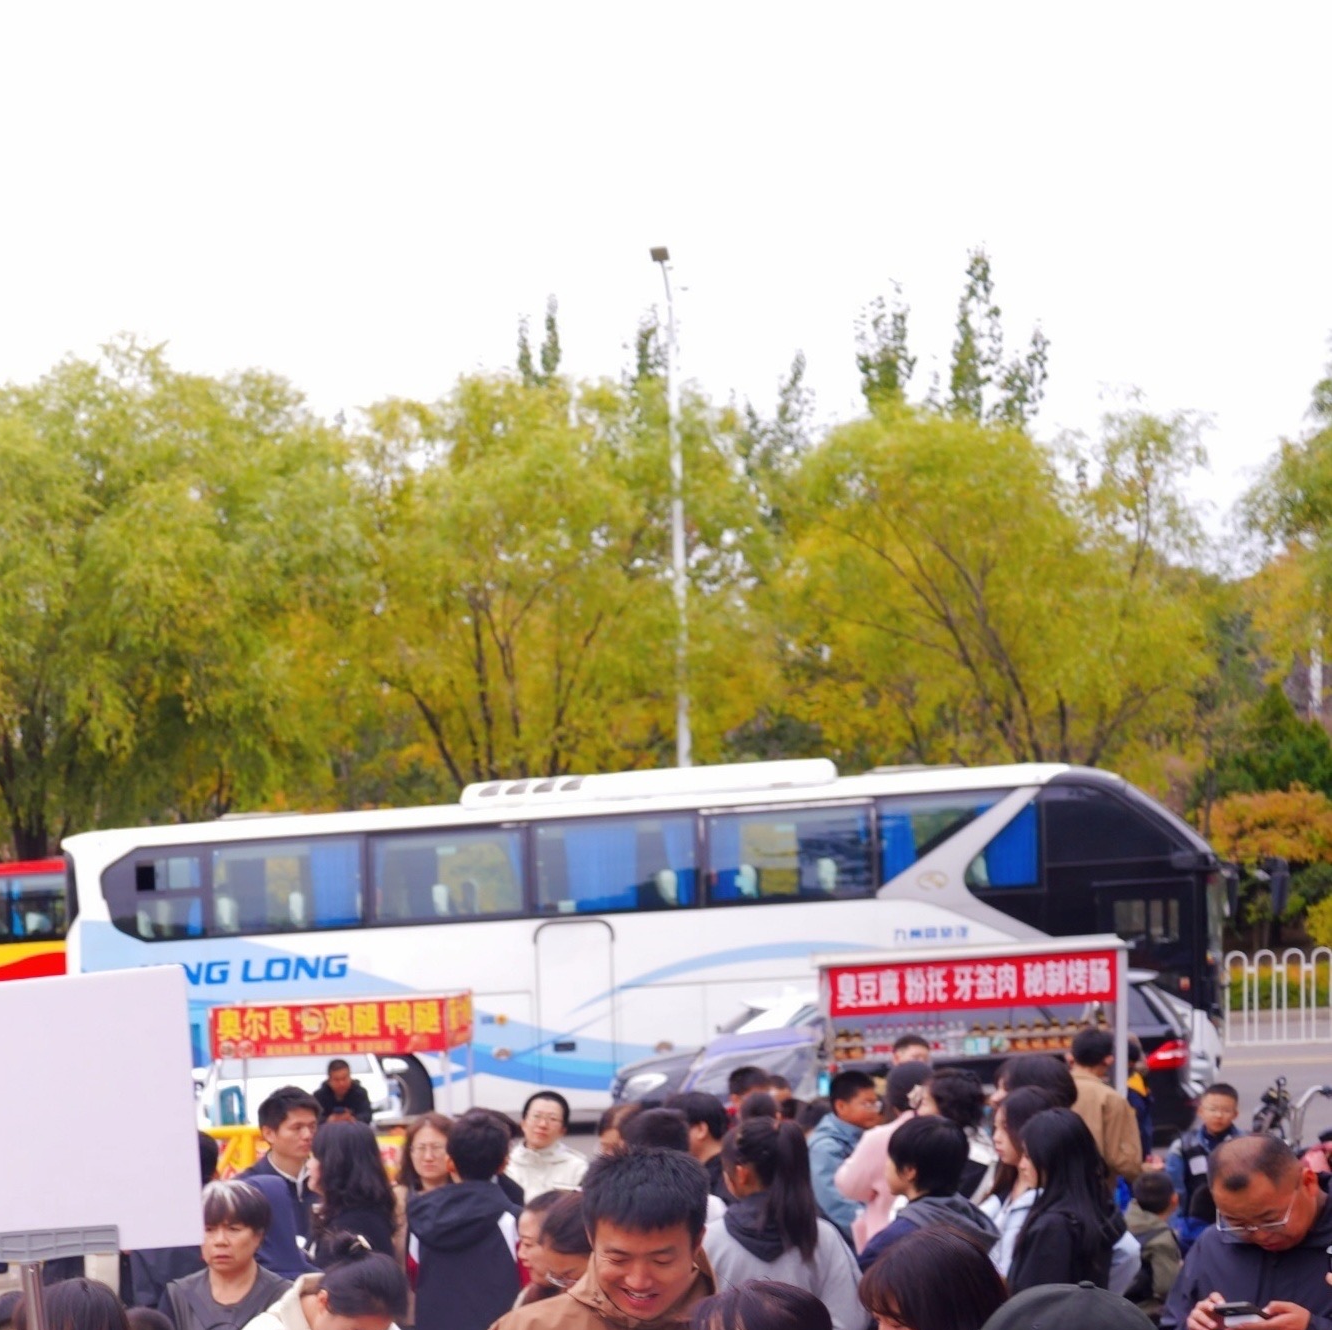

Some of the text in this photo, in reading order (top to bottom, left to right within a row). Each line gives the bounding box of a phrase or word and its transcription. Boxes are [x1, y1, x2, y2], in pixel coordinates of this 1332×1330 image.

[183, 954, 348, 986] NG LONG
[837, 971, 899, 1009] 臭豆腐
[217, 1008, 294, 1041] 奥尔良
